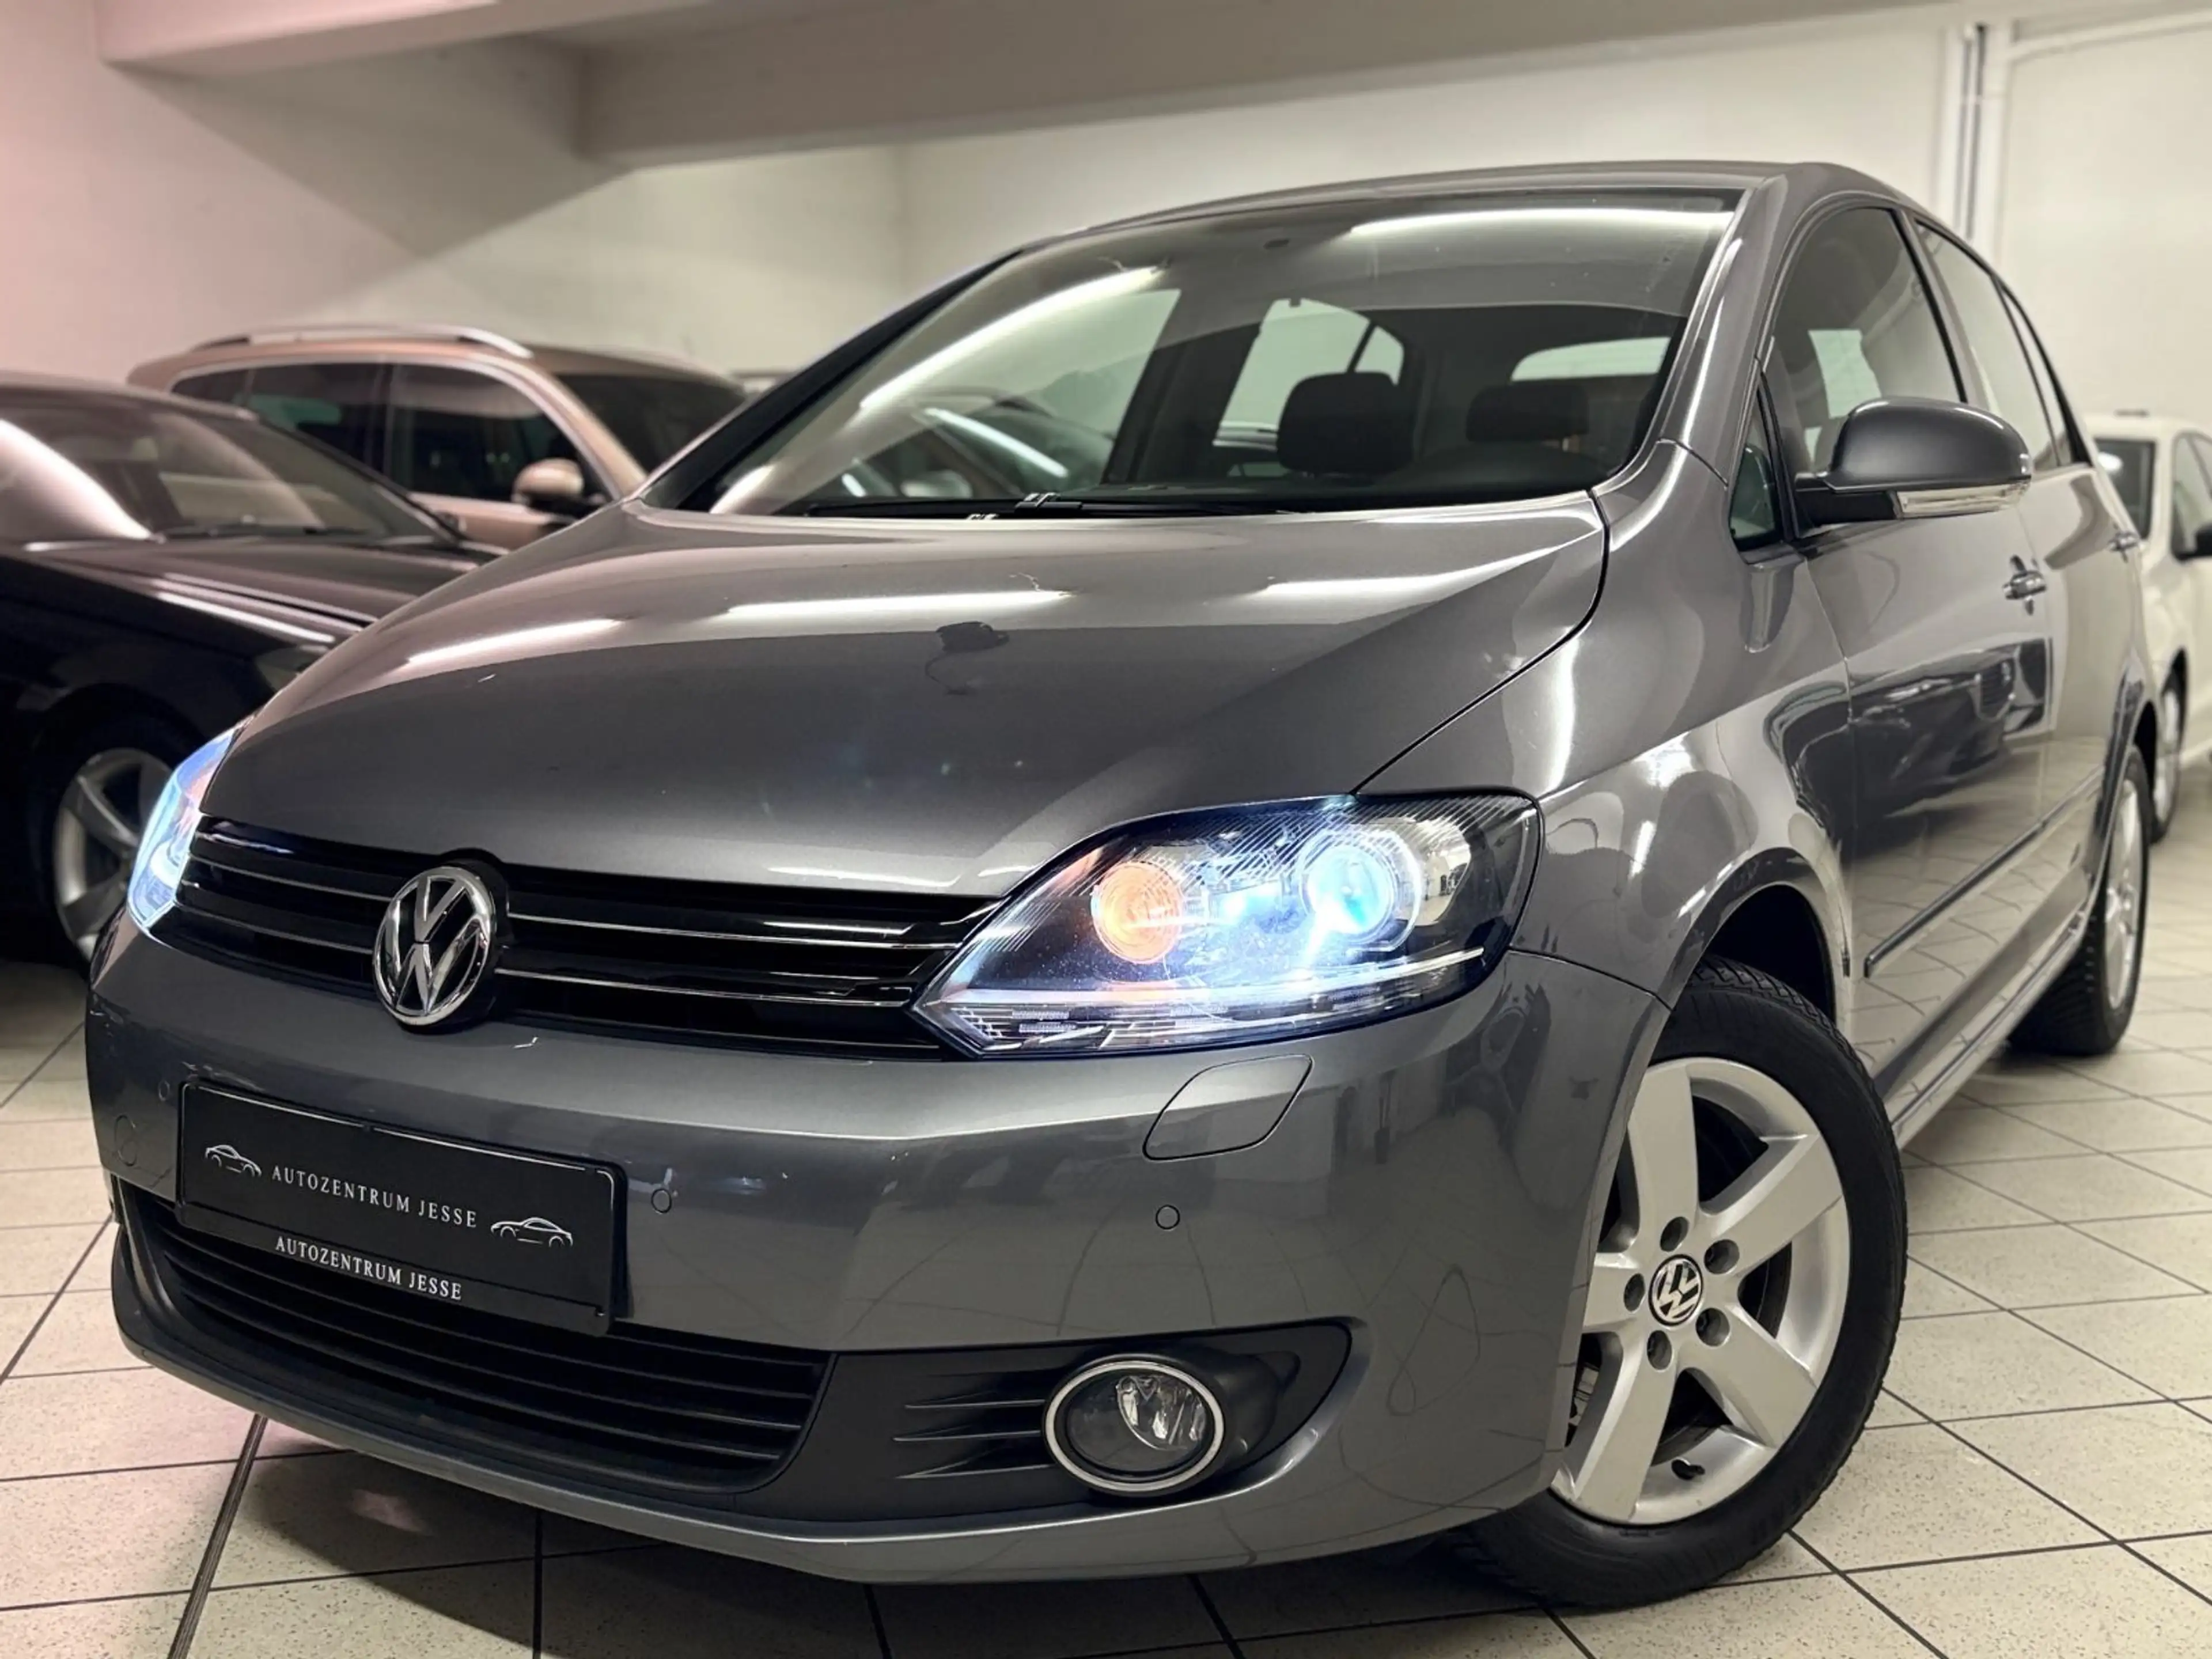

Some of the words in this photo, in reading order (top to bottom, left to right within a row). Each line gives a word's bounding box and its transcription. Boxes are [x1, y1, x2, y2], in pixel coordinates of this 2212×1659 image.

[374, 867, 495, 1025] VW
[271, 1165, 410, 1213] AUTOZENTRUM
[418, 1200, 478, 1228] JESSE
[274, 1235, 402, 1286] AUTOZENTRUM
[408, 1271, 463, 1301] JESSE
